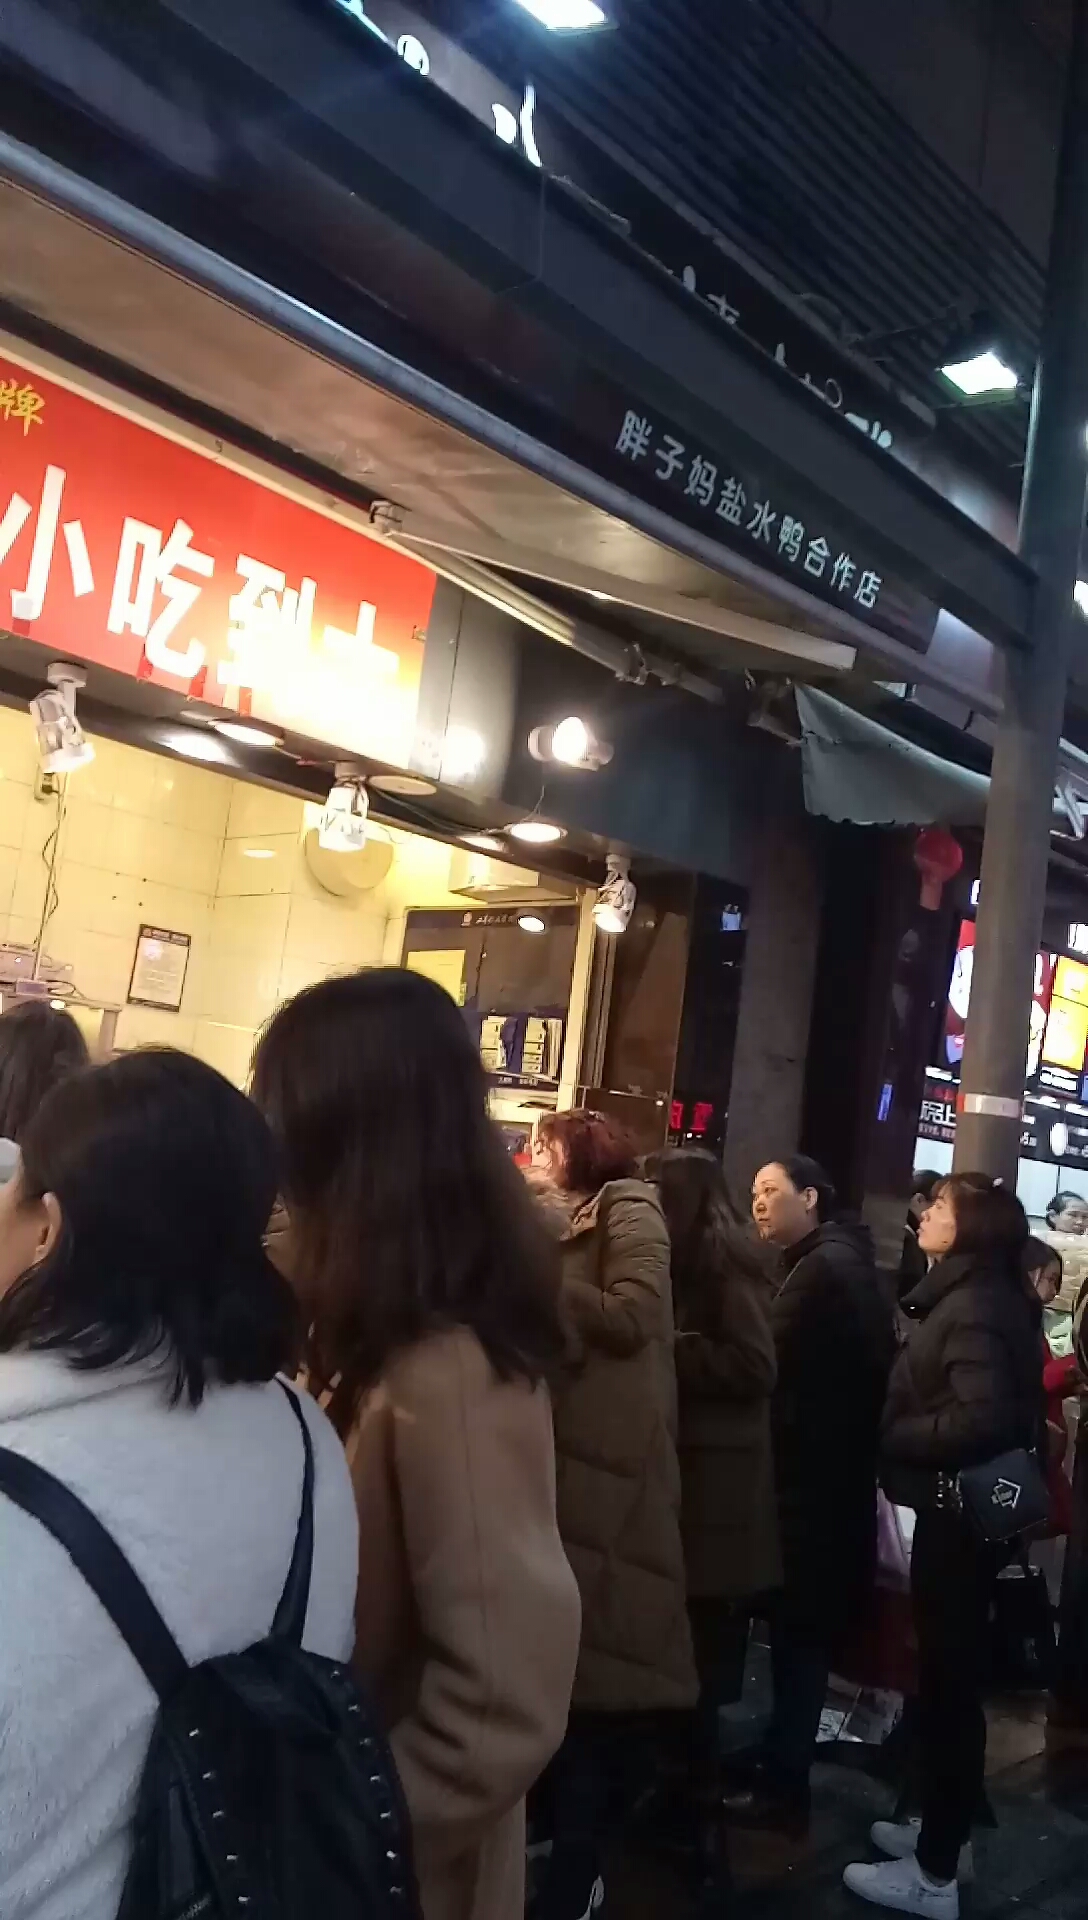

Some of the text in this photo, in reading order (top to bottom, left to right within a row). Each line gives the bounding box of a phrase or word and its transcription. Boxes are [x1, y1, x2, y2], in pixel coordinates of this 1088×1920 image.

[615, 409, 882, 608] 胖子妈盐水鸭合作店
